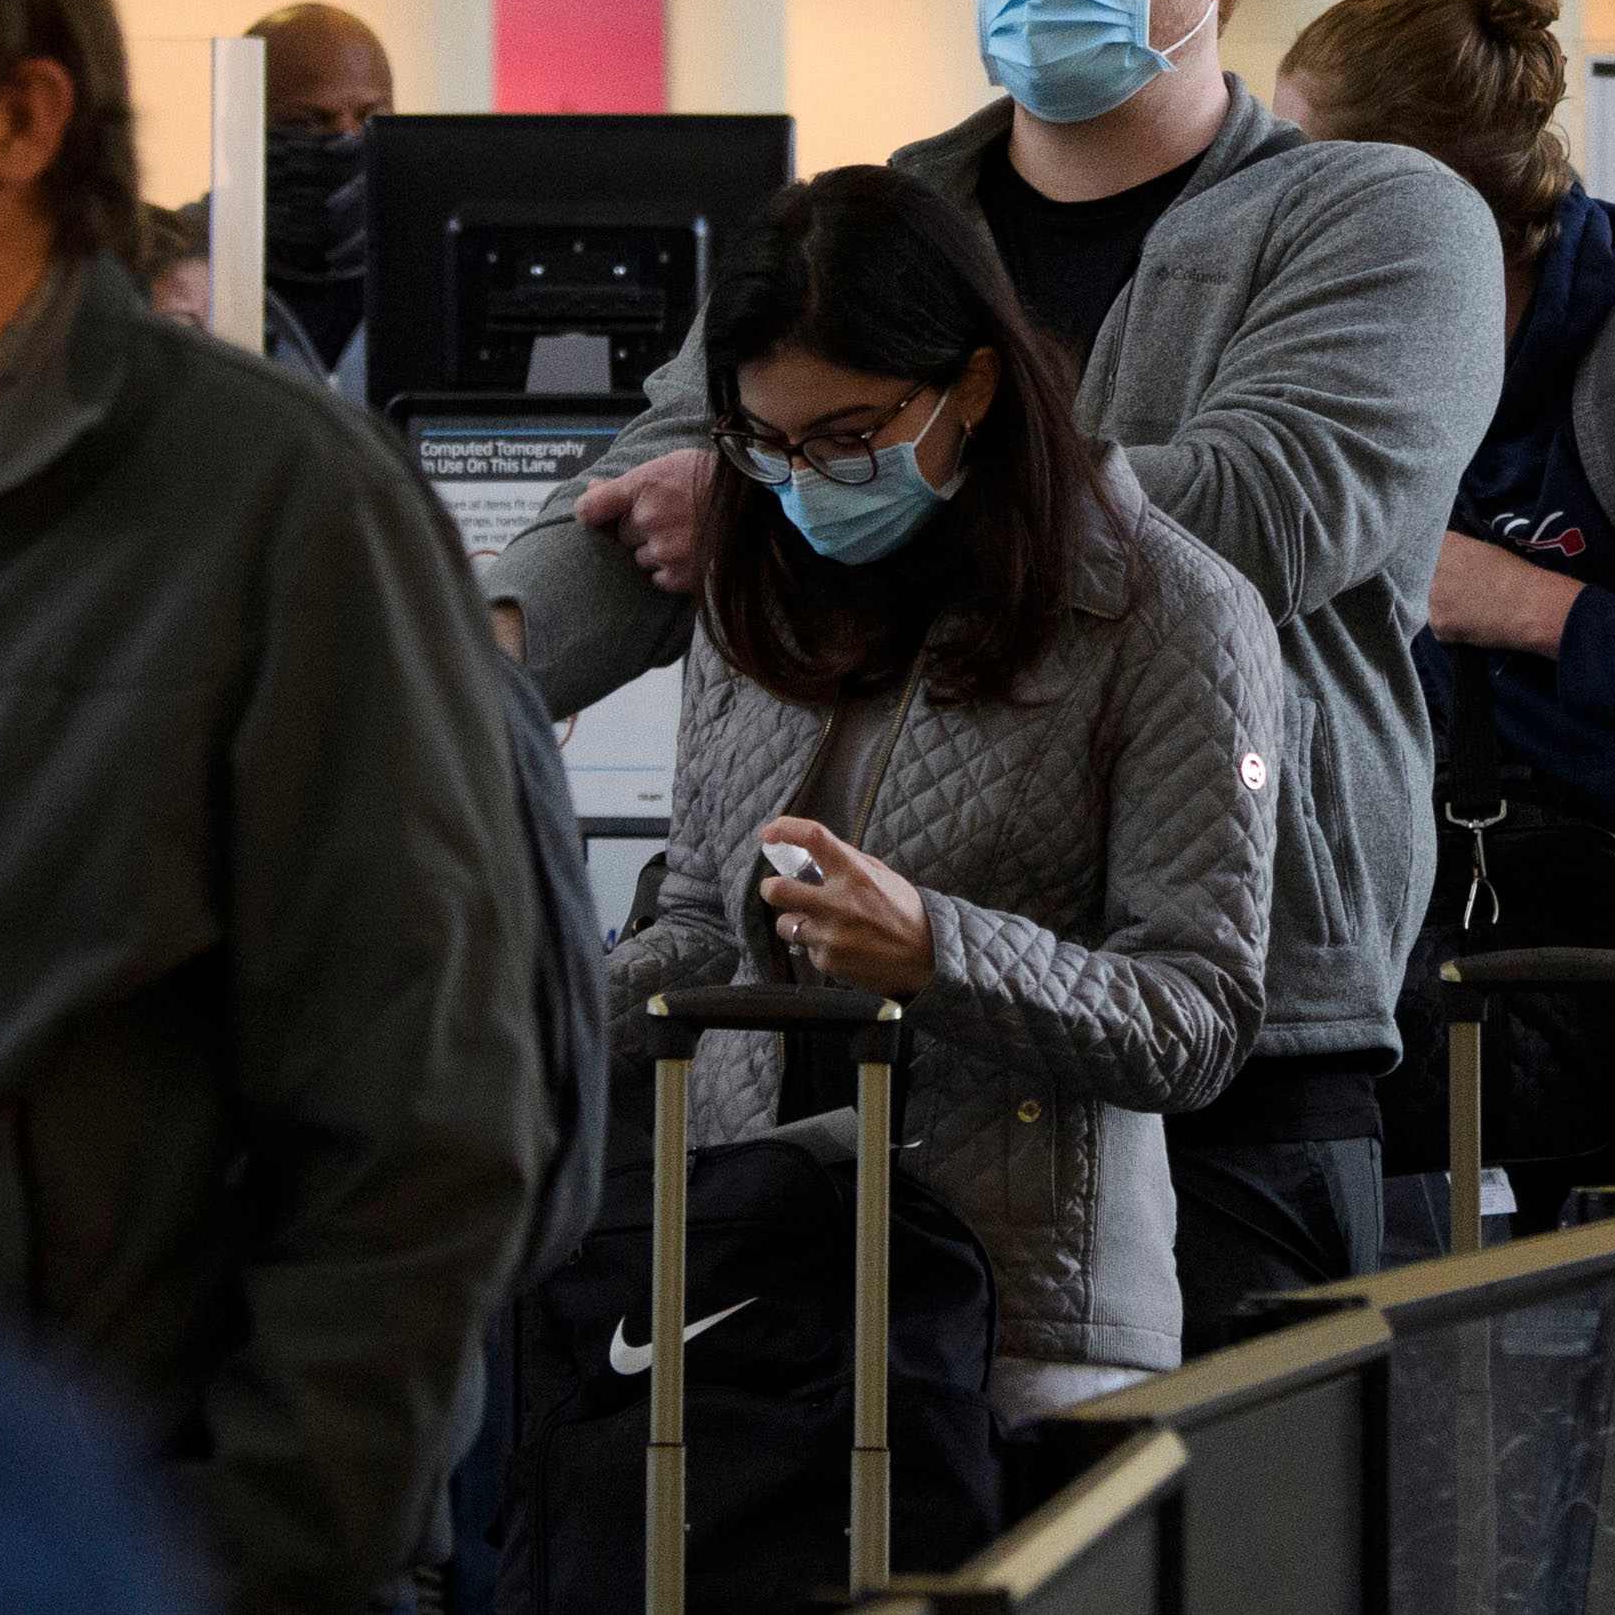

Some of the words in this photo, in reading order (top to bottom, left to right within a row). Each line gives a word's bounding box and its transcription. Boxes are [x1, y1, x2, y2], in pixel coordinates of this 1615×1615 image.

[420, 441, 494, 458] Computed
[495, 441, 586, 458] Tomography
[437, 459, 463, 474] Use
[466, 459, 486, 474] On
[488, 458, 519, 474] This
[522, 459, 557, 474] Lane
